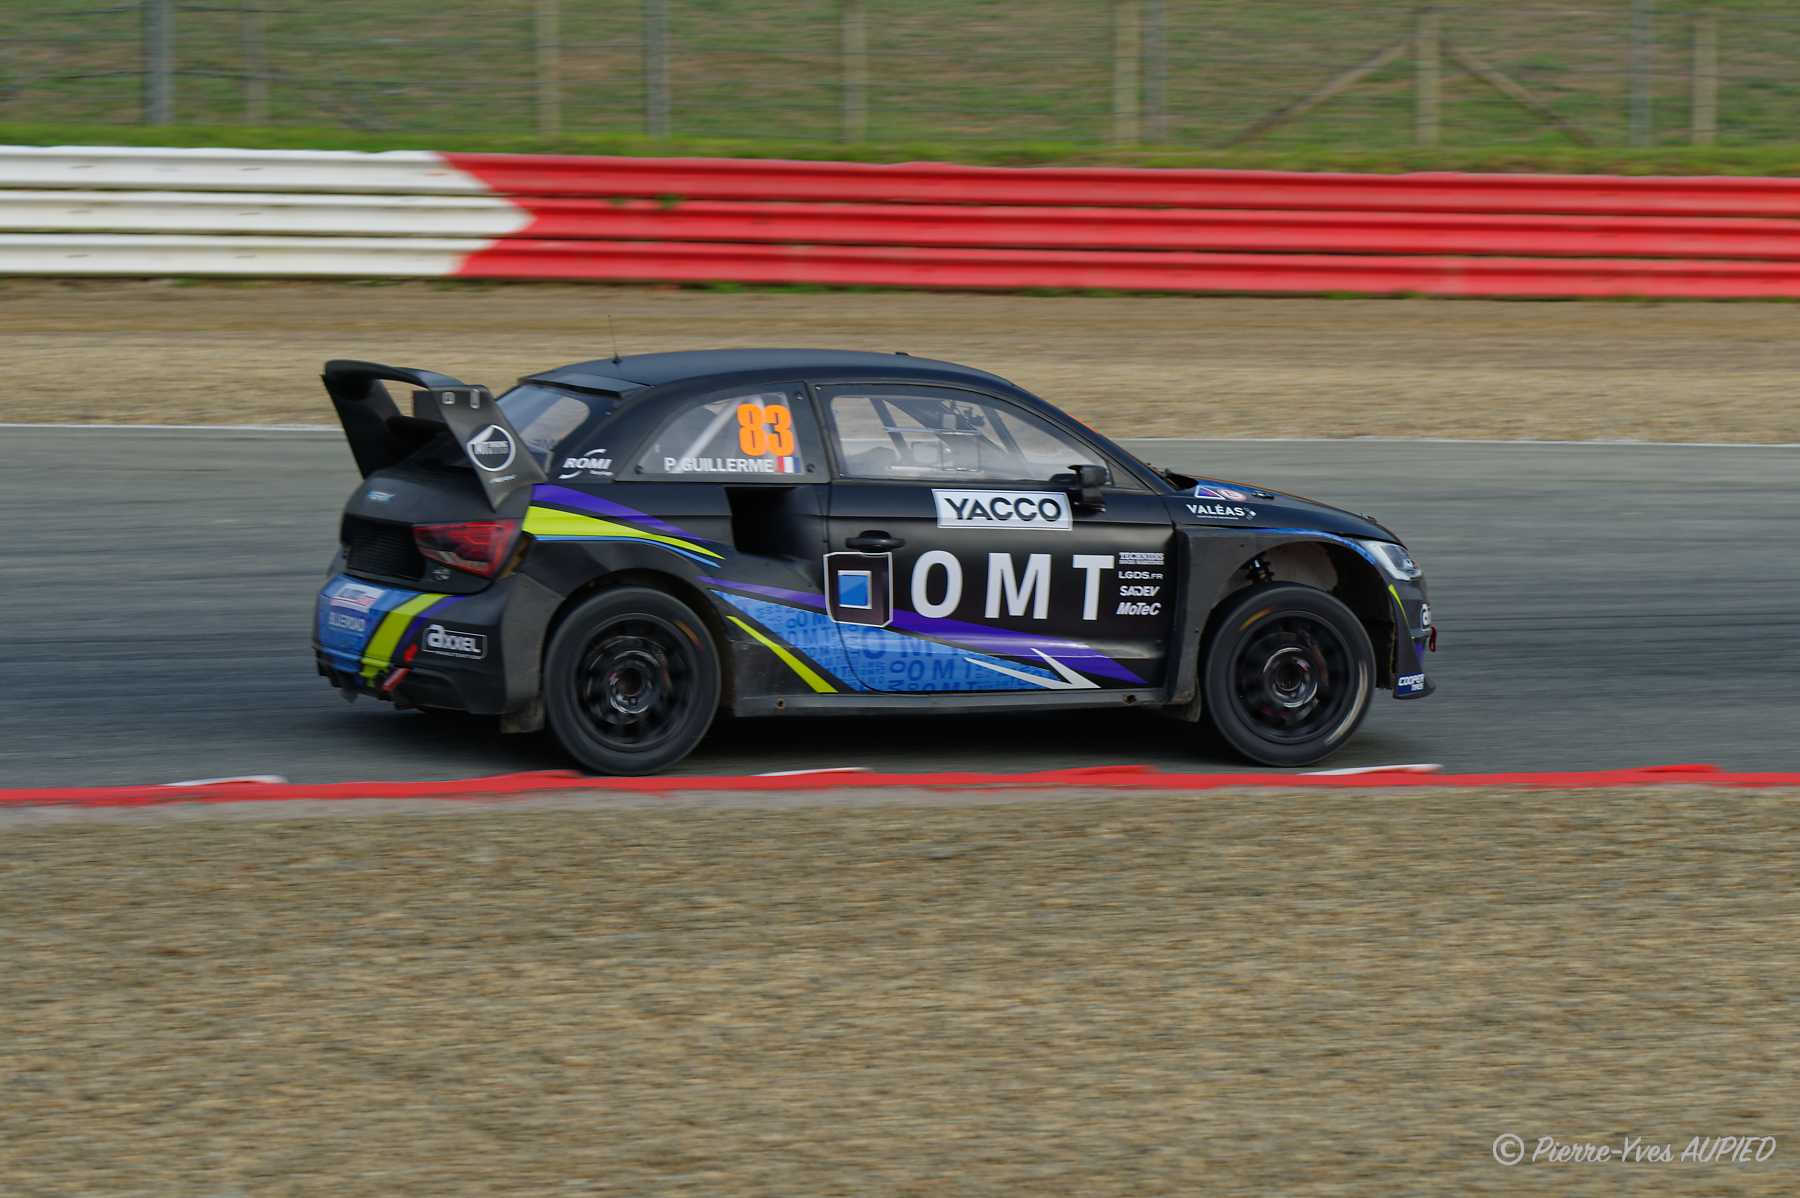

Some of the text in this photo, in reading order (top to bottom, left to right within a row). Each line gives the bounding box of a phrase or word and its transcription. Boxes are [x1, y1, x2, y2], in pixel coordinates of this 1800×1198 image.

[736, 403, 796, 457] 83
[563, 457, 613, 470] ROMI
[943, 497, 1062, 522] YACCO
[1186, 503, 1246, 517] VALÉAS
[911, 550, 1115, 621] OMT
[1116, 602, 1162, 616] MoTeC
